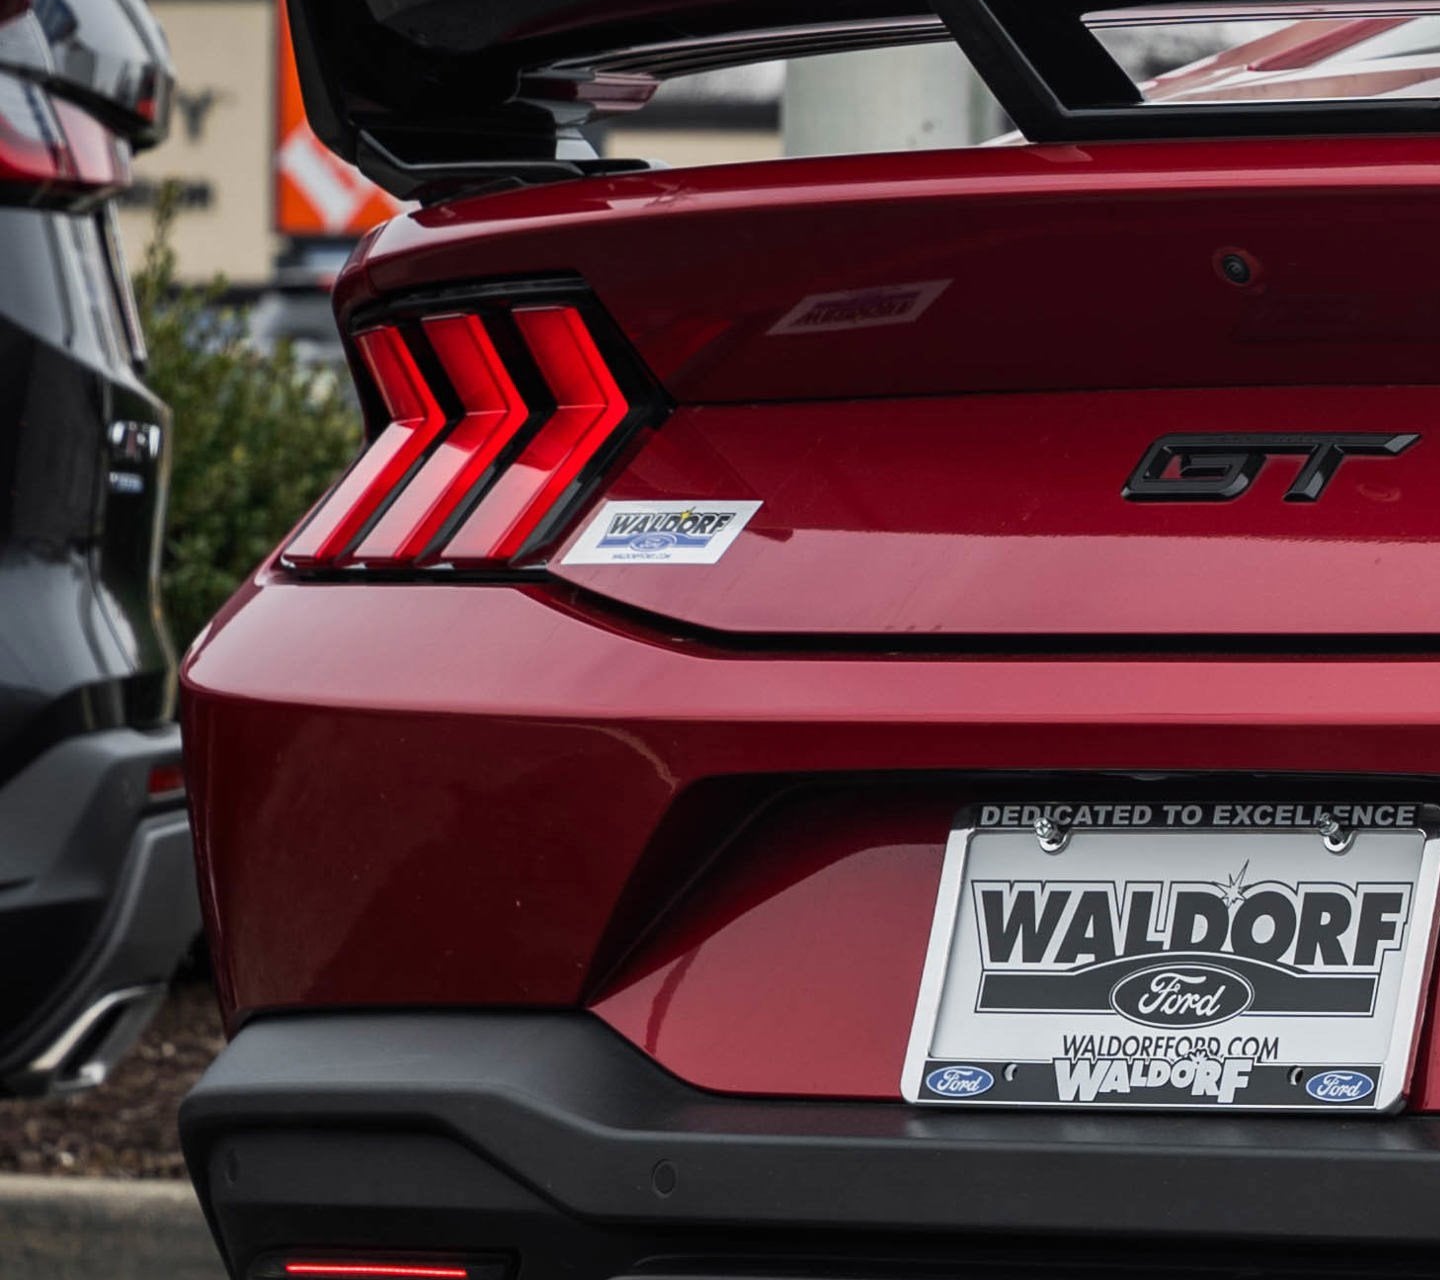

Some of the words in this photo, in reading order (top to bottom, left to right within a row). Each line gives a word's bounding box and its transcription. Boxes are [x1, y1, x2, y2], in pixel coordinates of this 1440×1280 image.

[1121, 431, 1421, 502] GT
[609, 512, 737, 535] WALDORF
[979, 805, 1153, 826] DEDICATED
[1163, 805, 1203, 826] TO
[1213, 806, 1416, 826] EXCELLENCE
[975, 883, 1410, 969] WALDORF
[1137, 971, 1221, 1017] Ford
[940, 1070, 981, 1094] Ford
[1053, 1057, 1253, 1104] WALDORF
[1319, 1074, 1363, 1099] Ford
